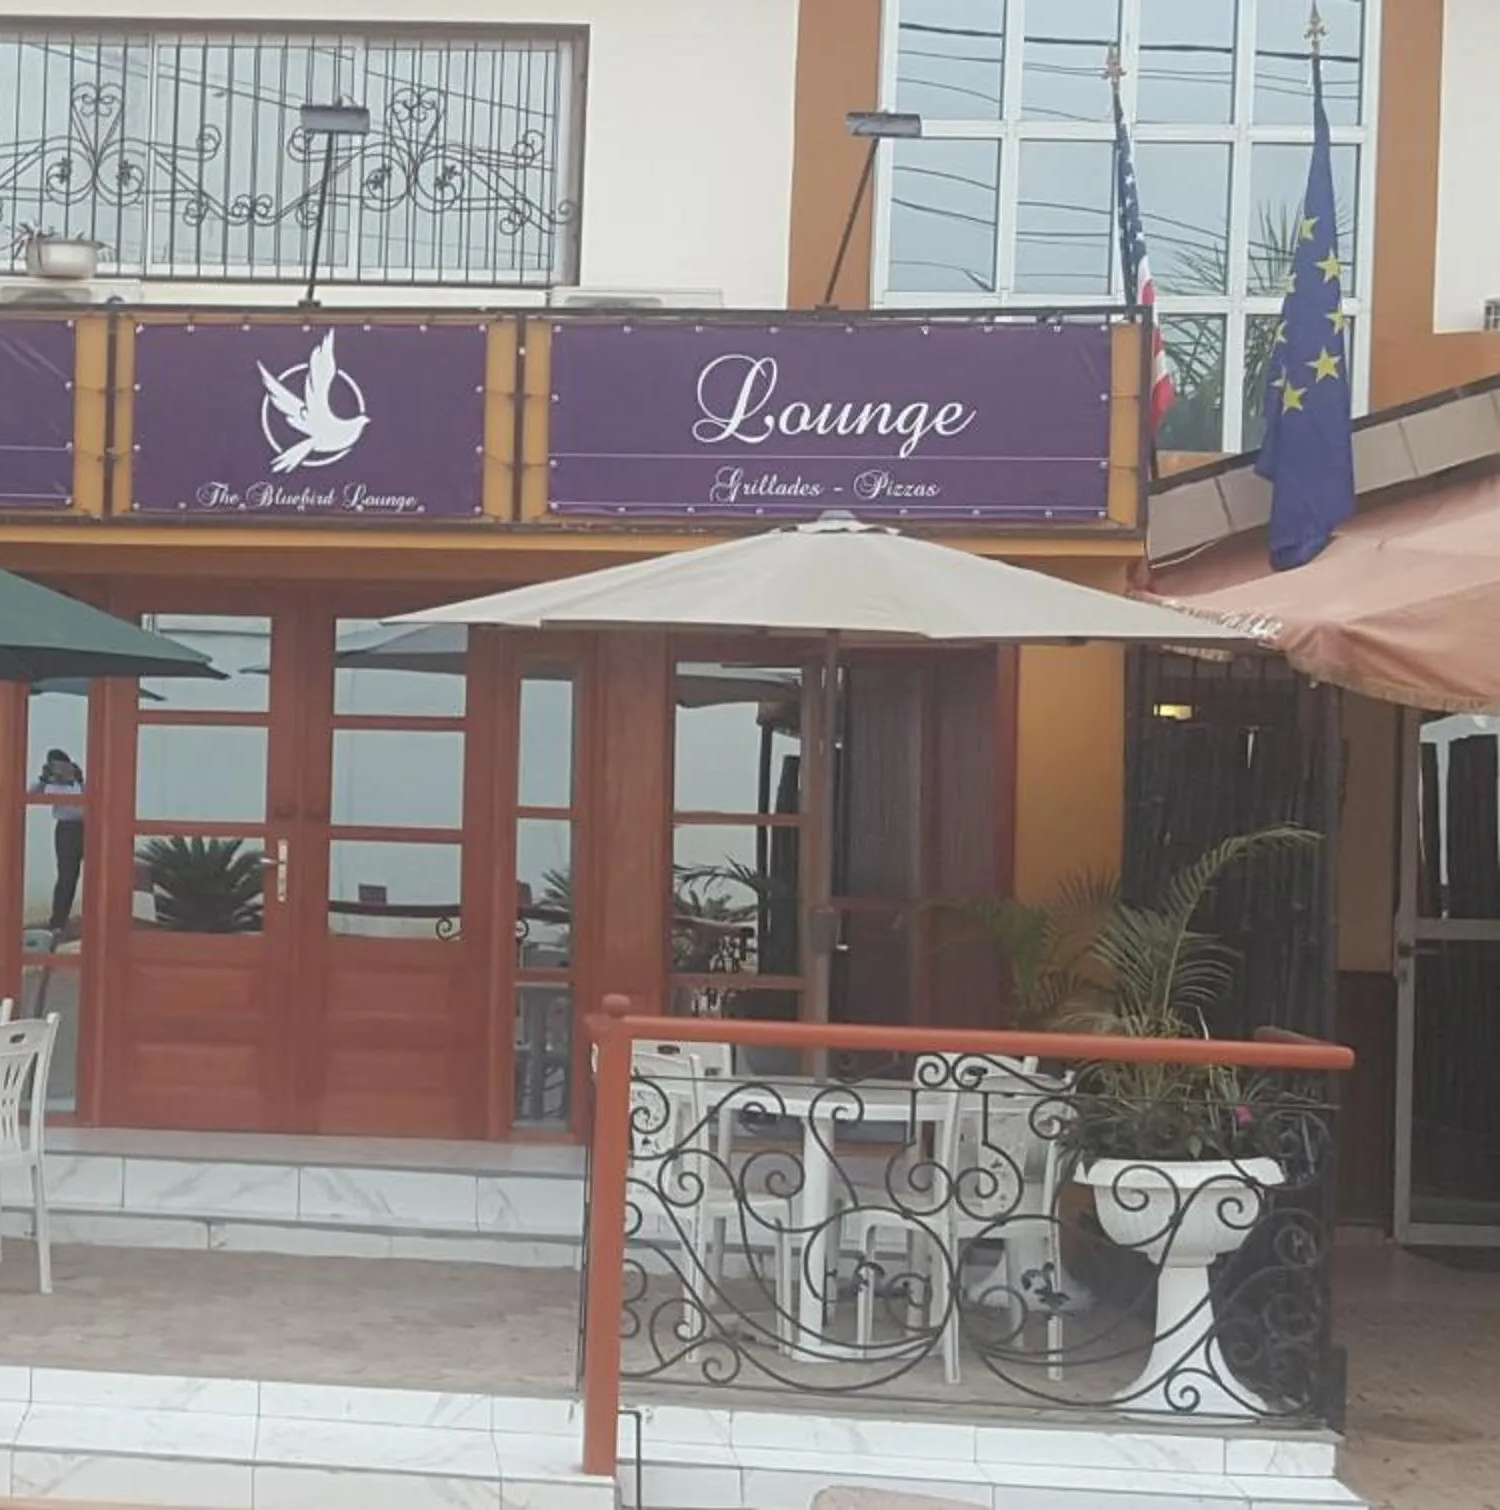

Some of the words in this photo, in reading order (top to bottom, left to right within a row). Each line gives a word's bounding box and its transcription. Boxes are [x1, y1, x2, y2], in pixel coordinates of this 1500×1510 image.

[692, 354, 977, 458] Lounge
[196, 481, 240, 507] The
[246, 481, 335, 507] Bluebird
[343, 483, 418, 513] Lounge
[710, 466, 826, 503] Grillades
[853, 469, 941, 499] Pizzas
